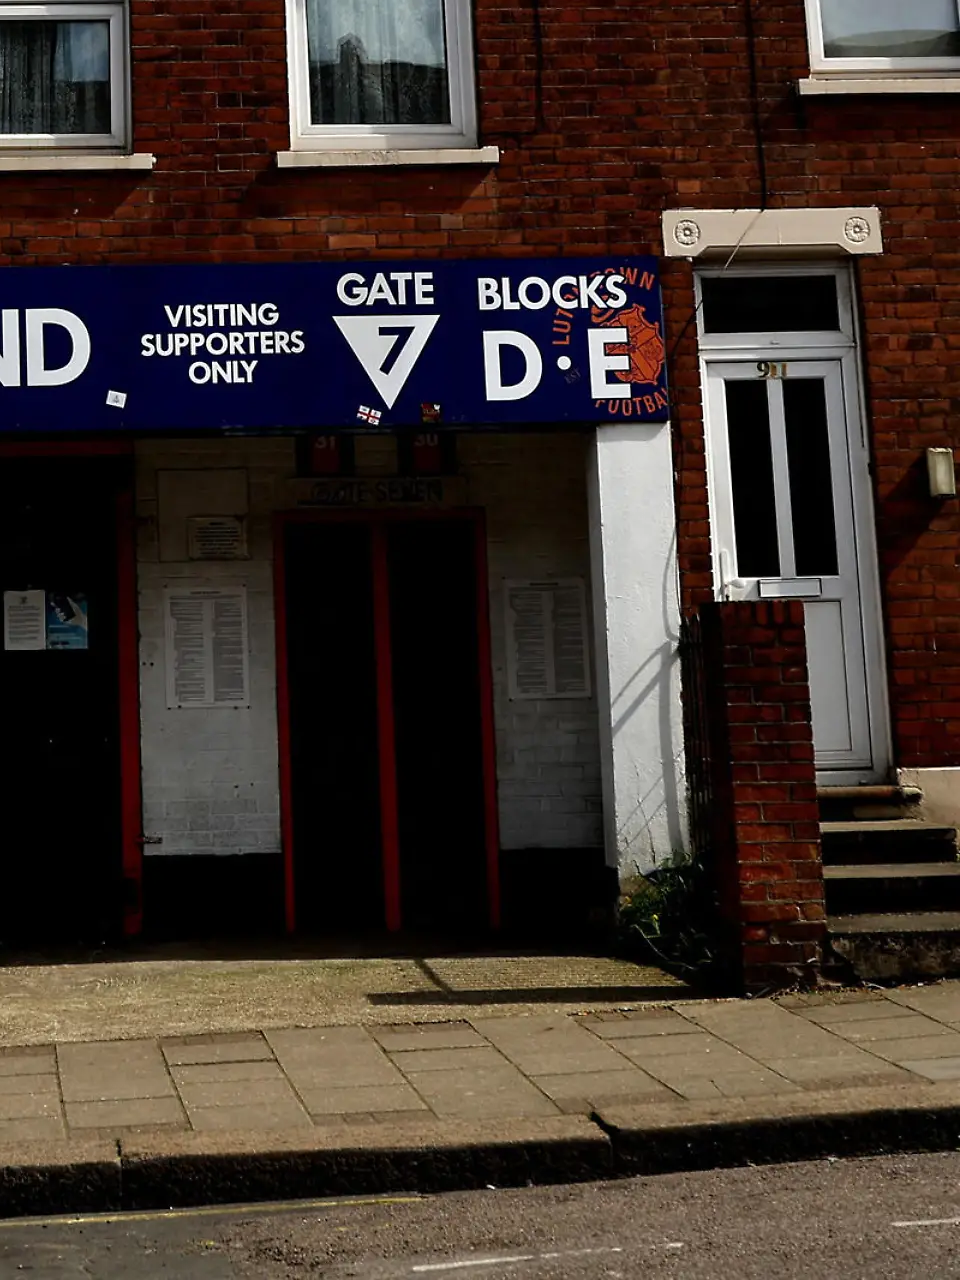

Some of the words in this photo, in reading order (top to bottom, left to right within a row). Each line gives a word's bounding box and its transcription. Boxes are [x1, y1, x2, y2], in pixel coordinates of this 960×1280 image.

[336, 271, 435, 307] GATE
[477, 274, 628, 311] BLOCKS
[163, 302, 280, 328] VISITING
[140, 330, 305, 357] SUPPORTERS
[378, 326, 416, 375] 7
[188, 359, 259, 385] ONLY
